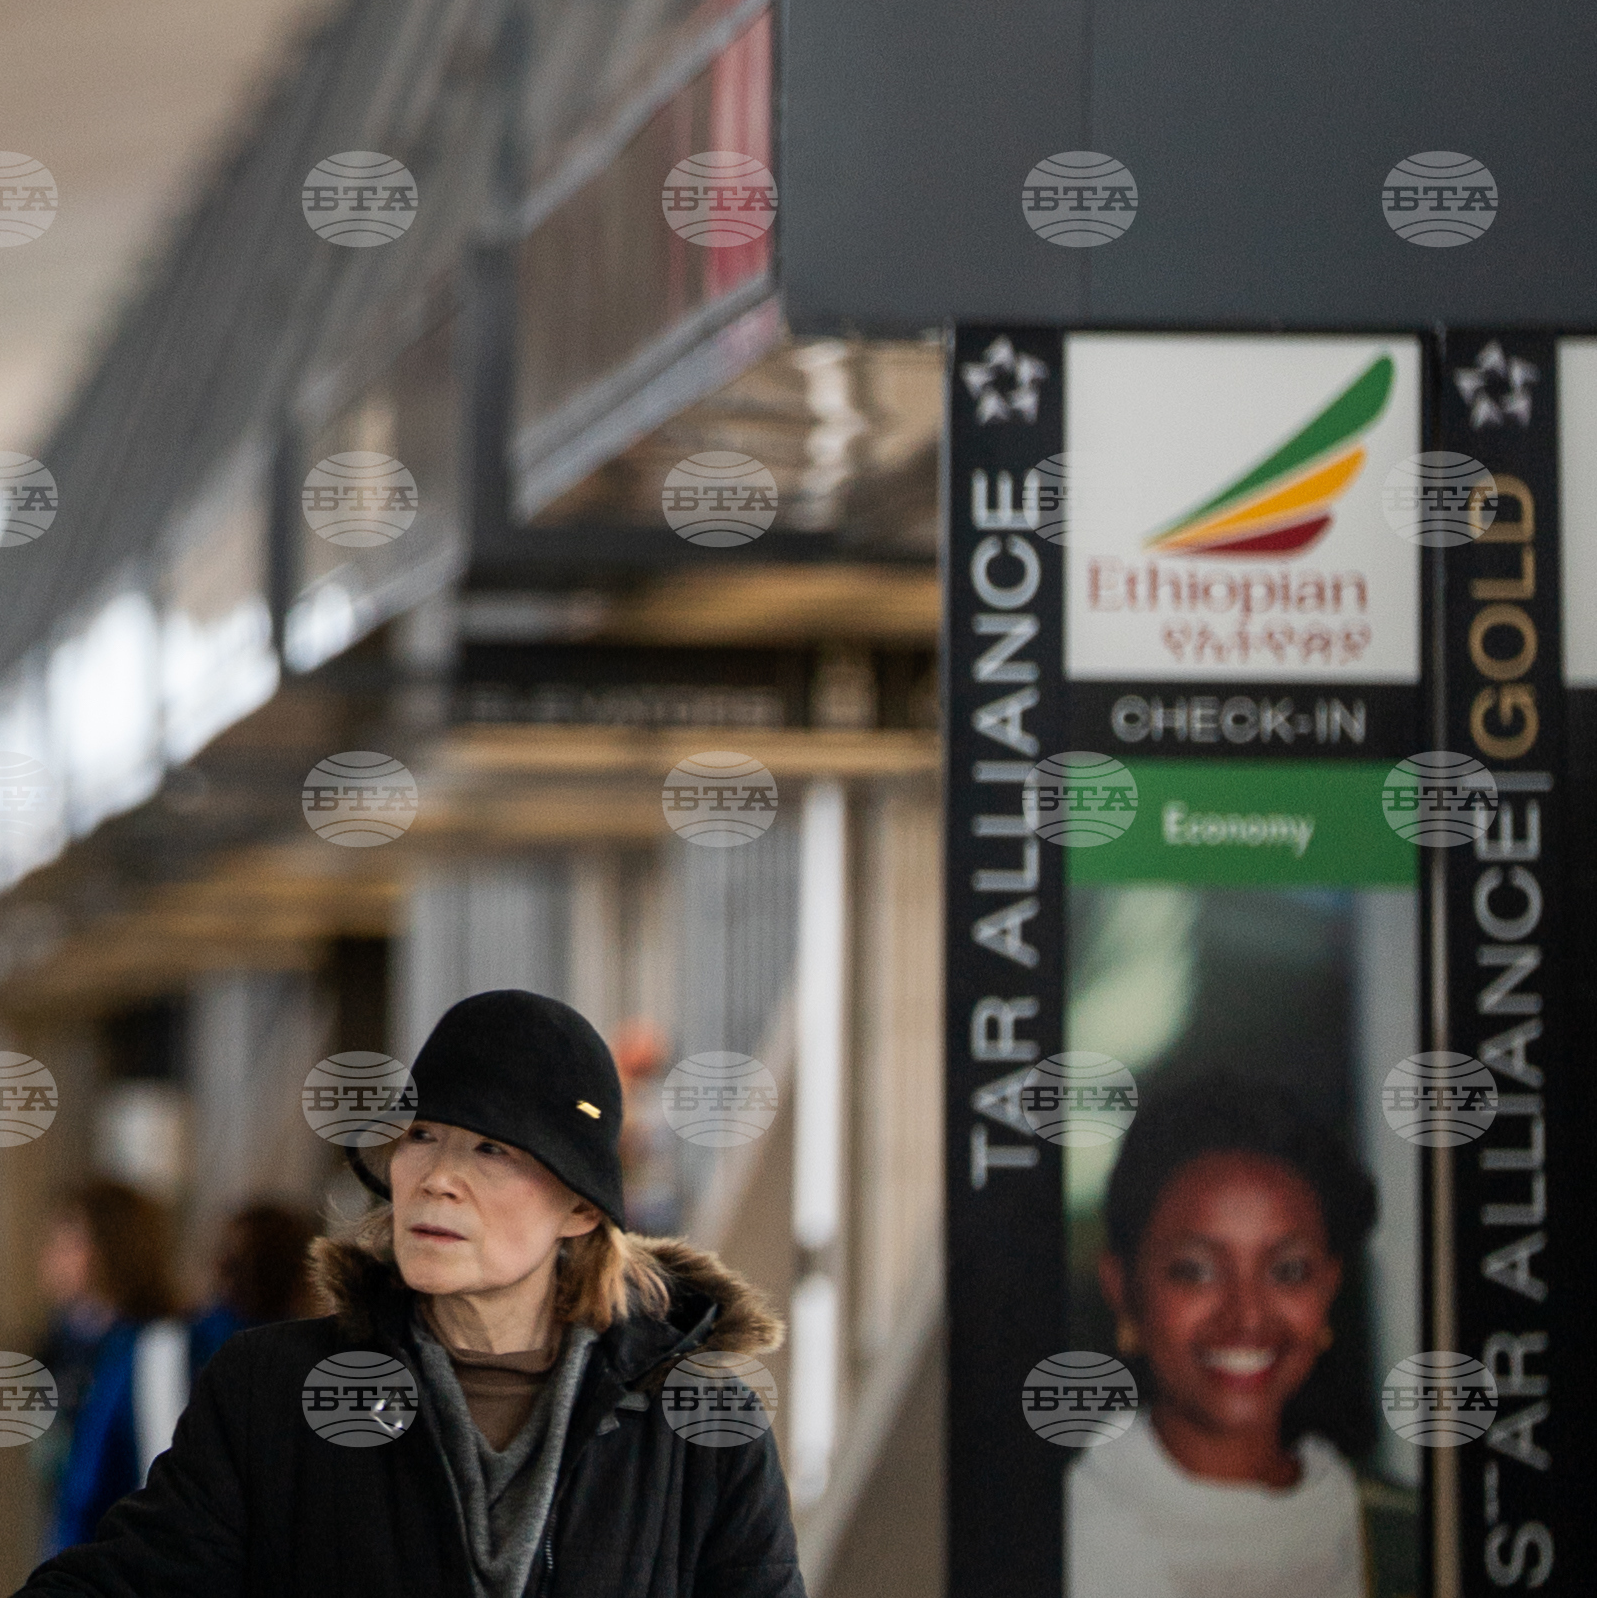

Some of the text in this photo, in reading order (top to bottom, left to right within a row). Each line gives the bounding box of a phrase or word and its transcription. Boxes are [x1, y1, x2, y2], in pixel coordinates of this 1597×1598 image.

[1087, 556, 1369, 618] Ethiopian
[1467, 471, 1540, 761] GOLD
[969, 467, 1043, 969] ALLIANCE
[1110, 693, 1368, 745] CHECK-IN
[1162, 800, 1317, 859] Economy
[1473, 797, 1550, 1304] ALLIANCE
